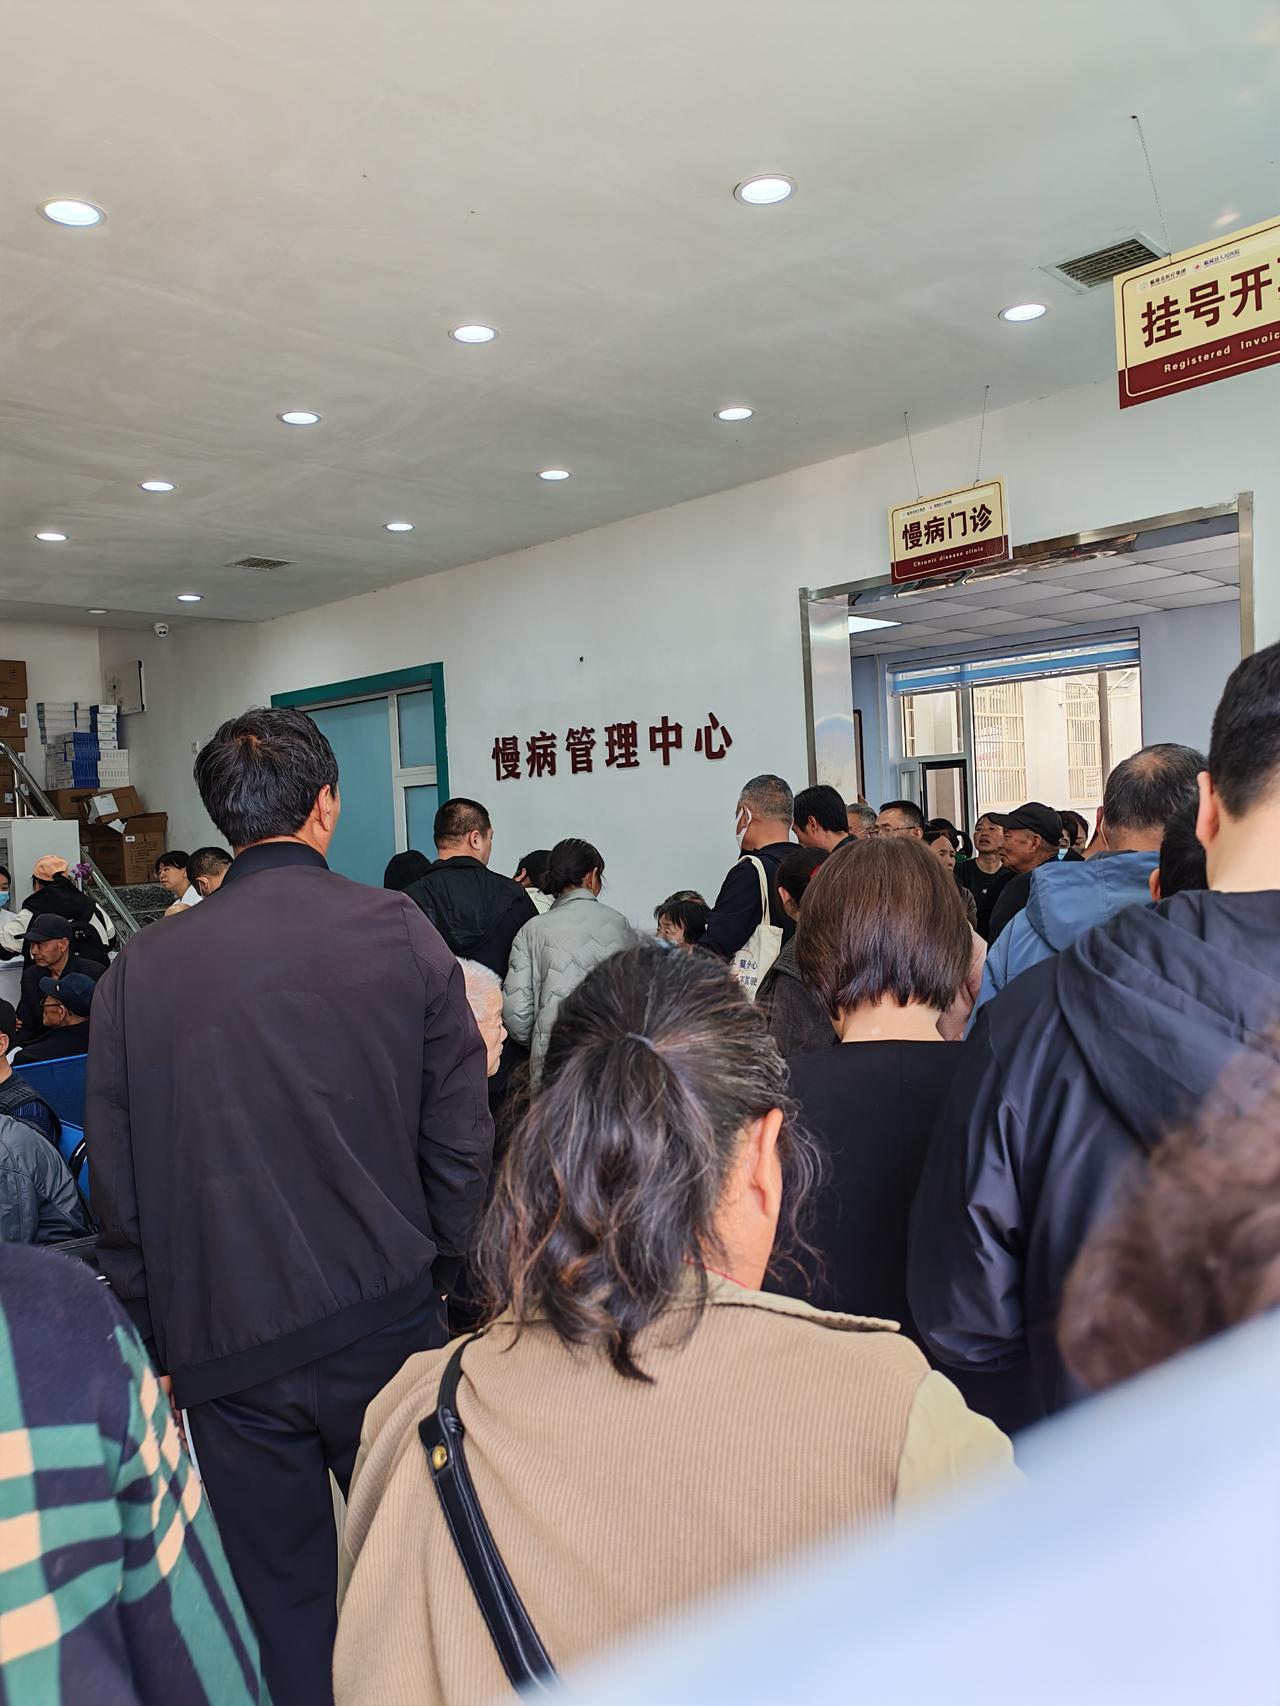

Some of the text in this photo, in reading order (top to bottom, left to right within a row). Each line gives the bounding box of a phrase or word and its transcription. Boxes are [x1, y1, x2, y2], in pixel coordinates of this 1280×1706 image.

[1141, 257, 1280, 348] 挂号开
[1164, 345, 1231, 373] Registered
[902, 504, 992, 551] 慢病门诊
[912, 546, 984, 567] Chronic disease clinic
[492, 712, 733, 781] 慢病管理中心
